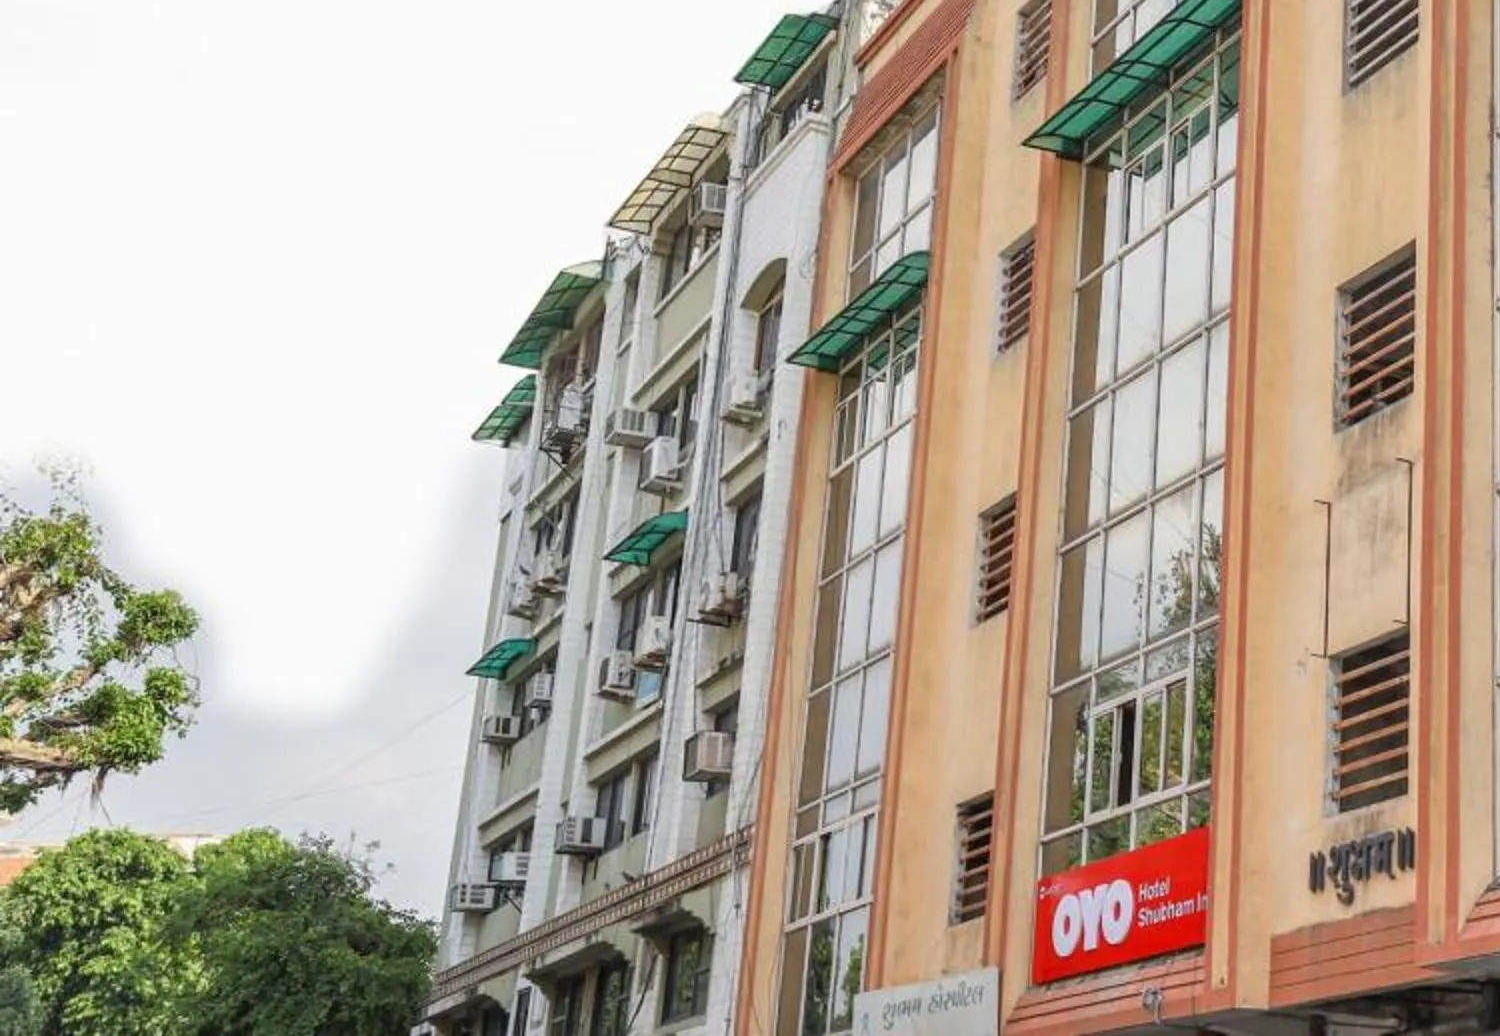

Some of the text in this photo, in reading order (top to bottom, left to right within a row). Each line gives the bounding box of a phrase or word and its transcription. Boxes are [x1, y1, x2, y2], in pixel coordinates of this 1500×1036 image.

[1138, 875, 1170, 902] Hotel
[1052, 879, 1134, 957] OYO
[1138, 900, 1194, 928] Shubham
